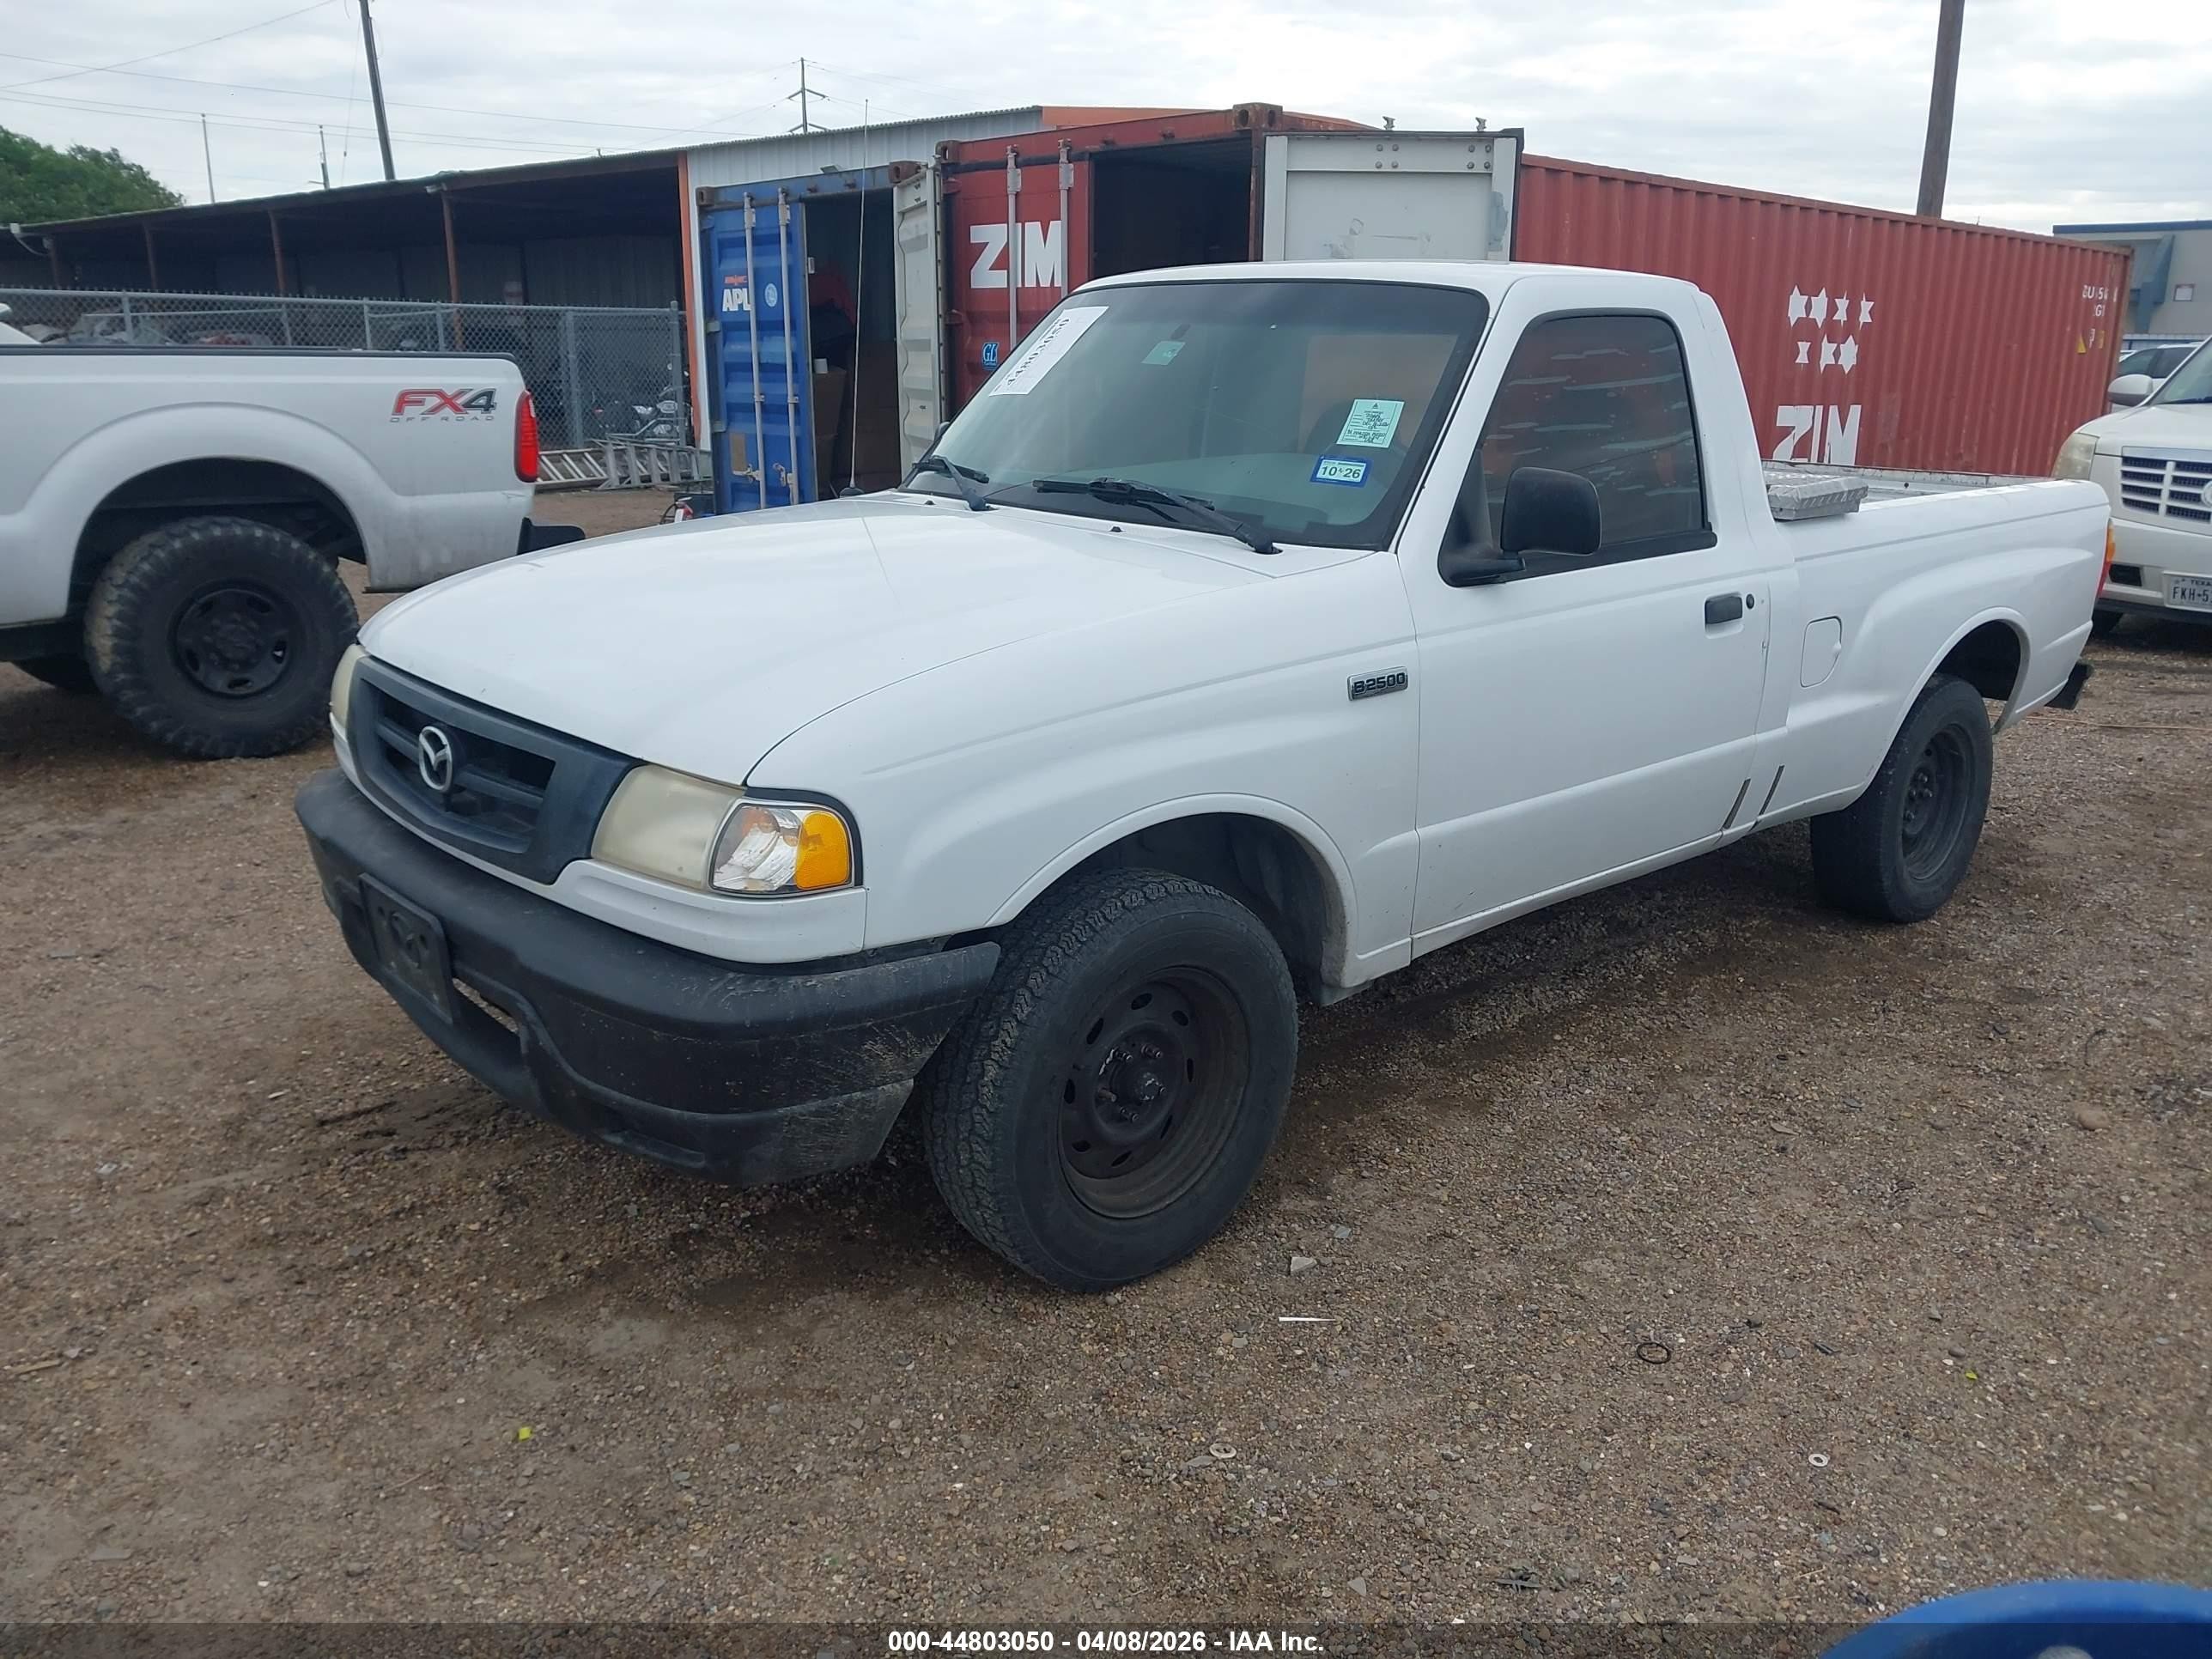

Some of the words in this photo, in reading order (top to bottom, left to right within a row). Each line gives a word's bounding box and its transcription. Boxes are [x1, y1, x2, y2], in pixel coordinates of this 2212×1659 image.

[969, 220, 1061, 289] ZIM
[722, 288, 752, 311] APL
[392, 388, 497, 416] FX4
[1772, 404, 1862, 465] ZIM
[1322, 466, 1338, 477] 10
[1343, 468, 1362, 479] 26
[2172, 586, 2212, 603] FKH-5
[1353, 672, 1406, 693] B2500
